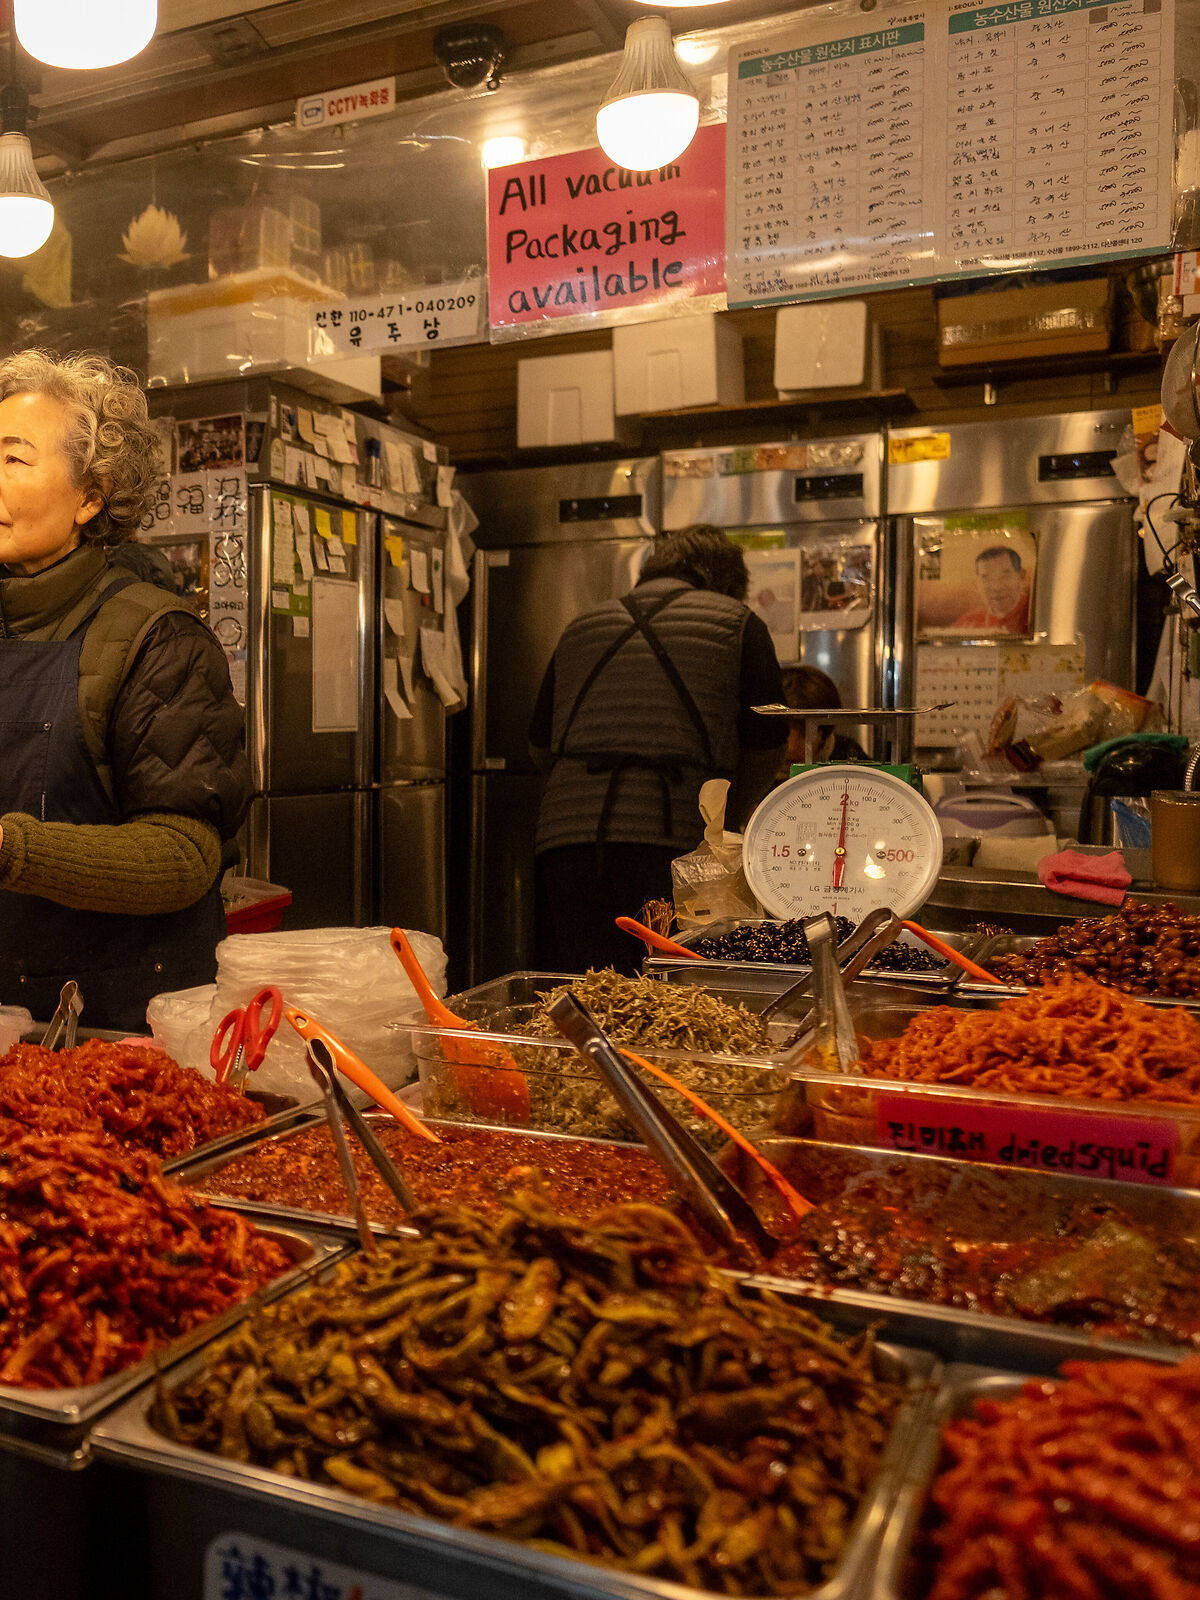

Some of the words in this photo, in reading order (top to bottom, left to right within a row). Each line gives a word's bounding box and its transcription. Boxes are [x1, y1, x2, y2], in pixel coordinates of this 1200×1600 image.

[973, 3, 1032, 27] 농수산물
[760, 50, 812, 73] 농수산물
[815, 40, 856, 60] 원산지
[859, 30, 901, 50] 표시판
[327, 87, 390, 117] CCTV녹화중
[499, 173, 547, 216] All
[506, 210, 687, 264] Packaging
[1130, 237, 1143, 245] 120
[507, 257, 684, 314] available
[315, 309, 344, 328] 신한
[349, 295, 476, 323] 110-471-040209
[771, 845, 791, 858] 1.5
[886, 850, 915, 863] 500
[831, 902, 838, 915] 1
